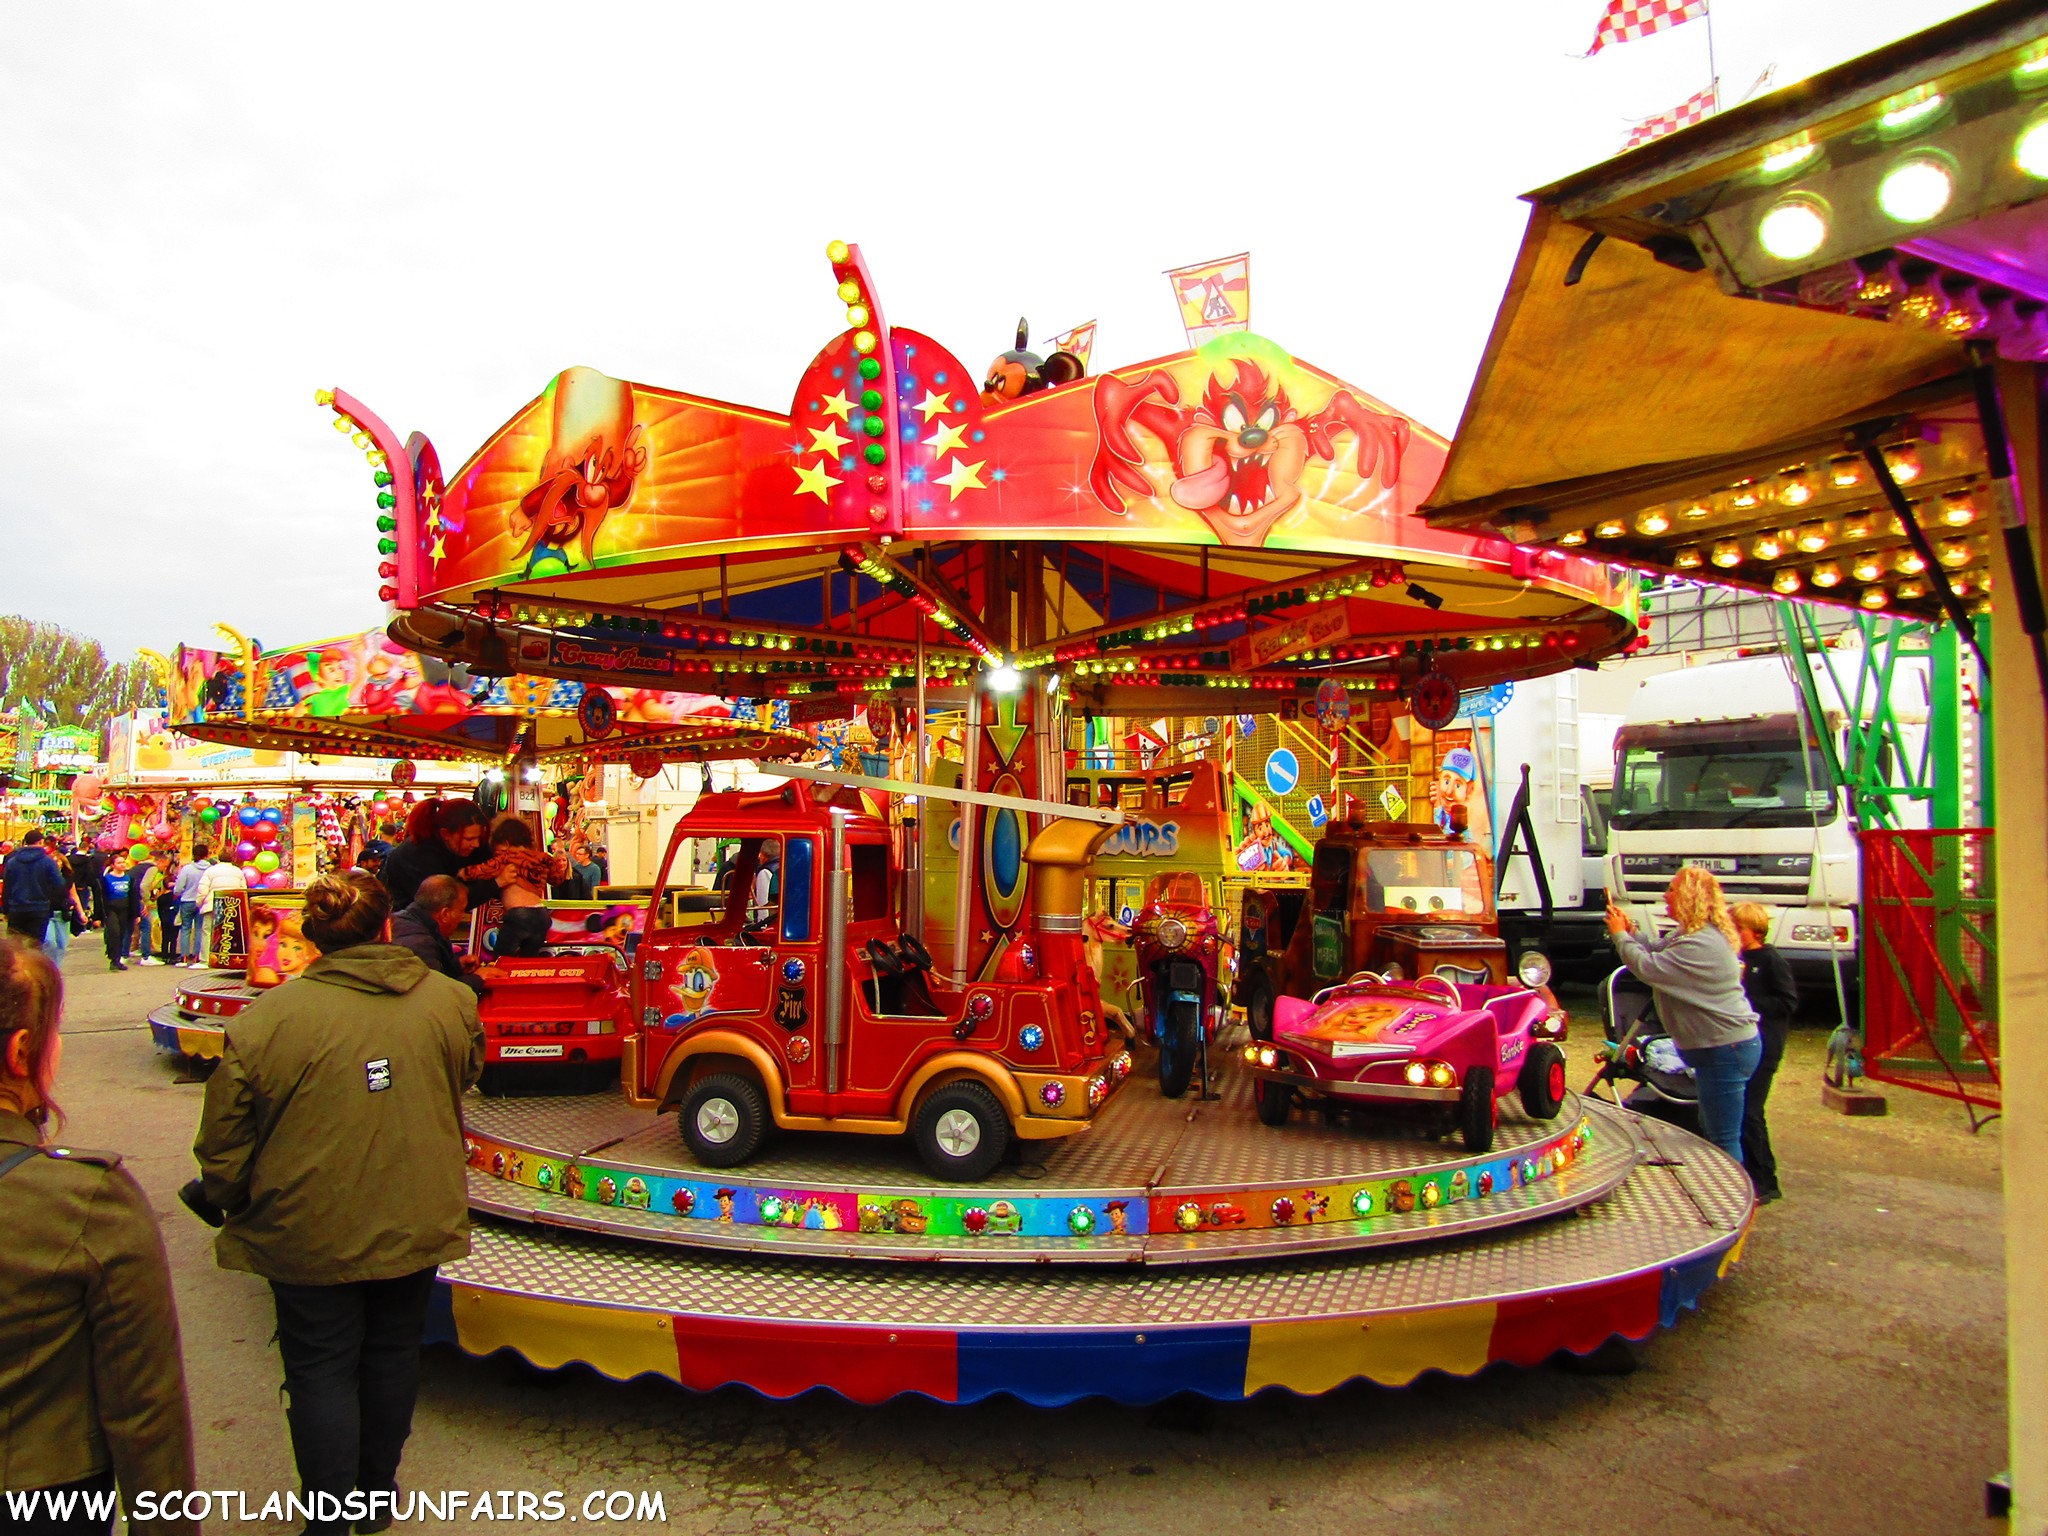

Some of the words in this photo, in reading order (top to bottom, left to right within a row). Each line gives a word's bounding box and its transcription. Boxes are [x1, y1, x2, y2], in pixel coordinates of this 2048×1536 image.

[556, 641, 615, 670] Crazy
[613, 647, 671, 672] Races
[519, 791, 535, 801] B22
[1624, 858, 1660, 866] DAF
[1777, 857, 1810, 867] CF
[510, 969, 556, 978] PISTON
[558, 968, 585, 978] CUP
[780, 991, 802, 1024] Fire
[526, 1046, 559, 1055] Queen
[1501, 1037, 1524, 1062] Barbie
